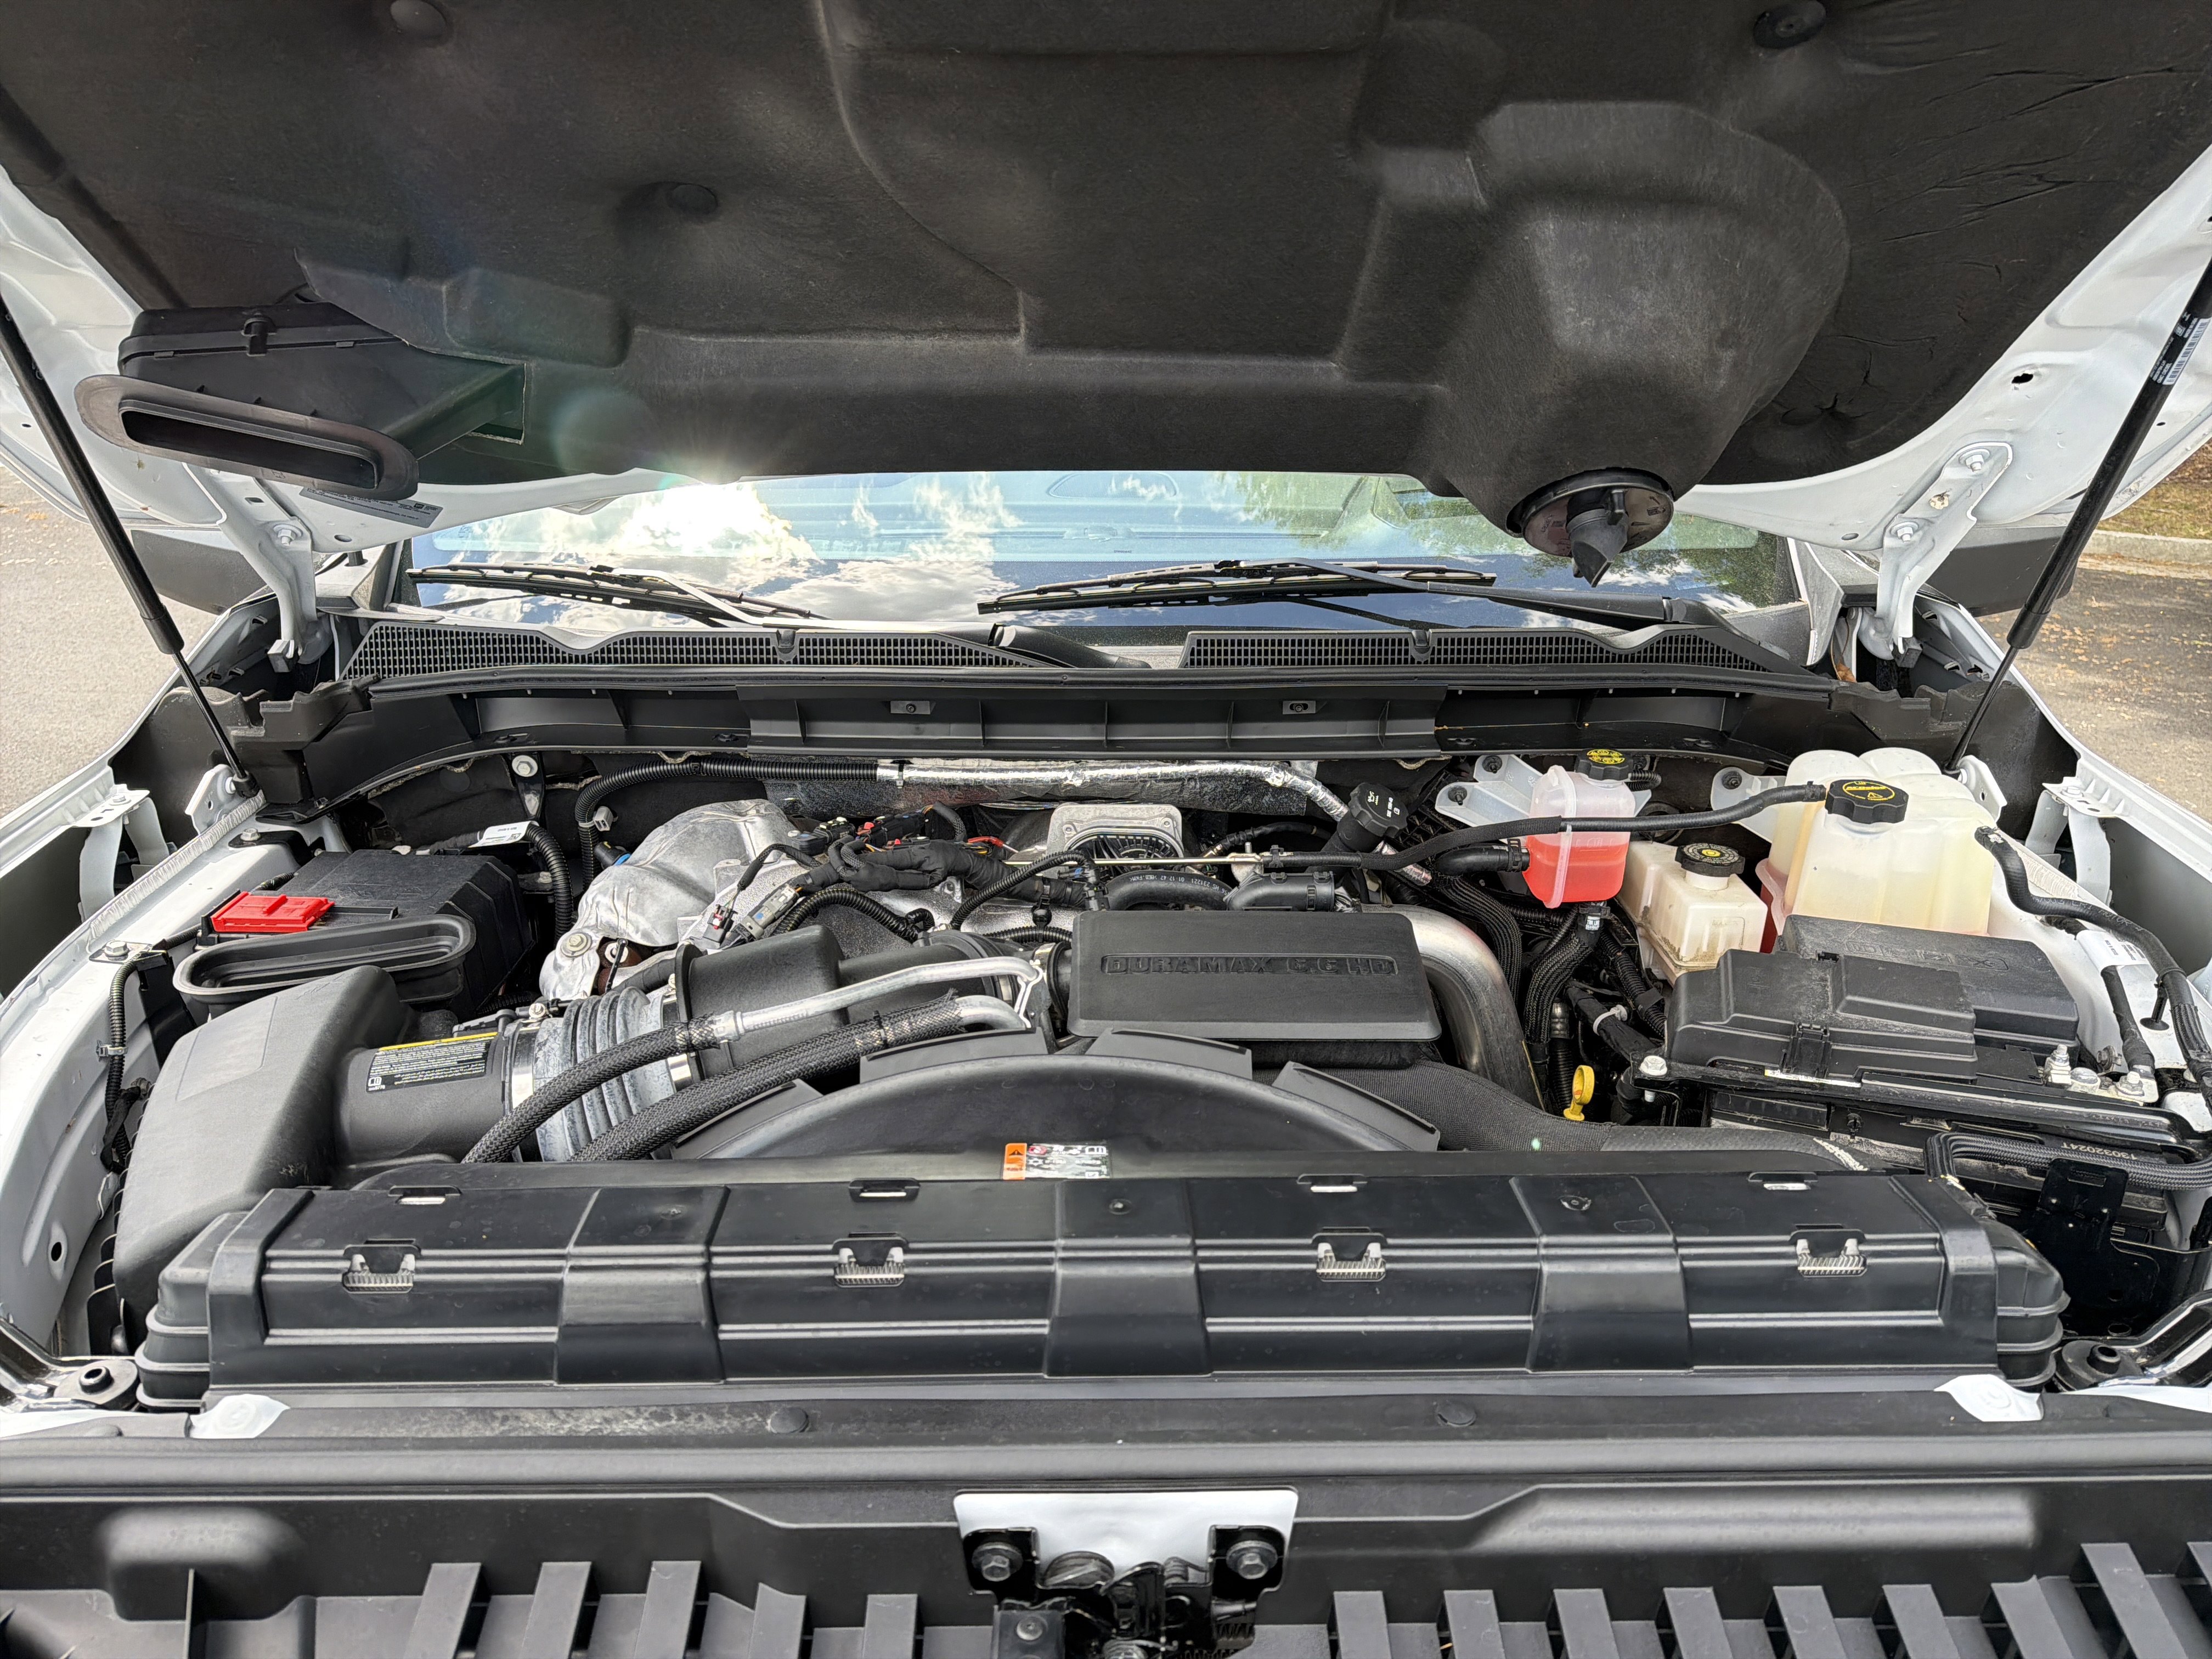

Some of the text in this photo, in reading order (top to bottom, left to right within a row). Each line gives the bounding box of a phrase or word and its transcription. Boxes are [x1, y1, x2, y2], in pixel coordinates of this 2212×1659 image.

[1189, 878, 1210, 887] 231221
[1105, 957, 1395, 975] DURAMAX 6.6 HD
[2061, 1142, 2137, 1160] 13032024T
